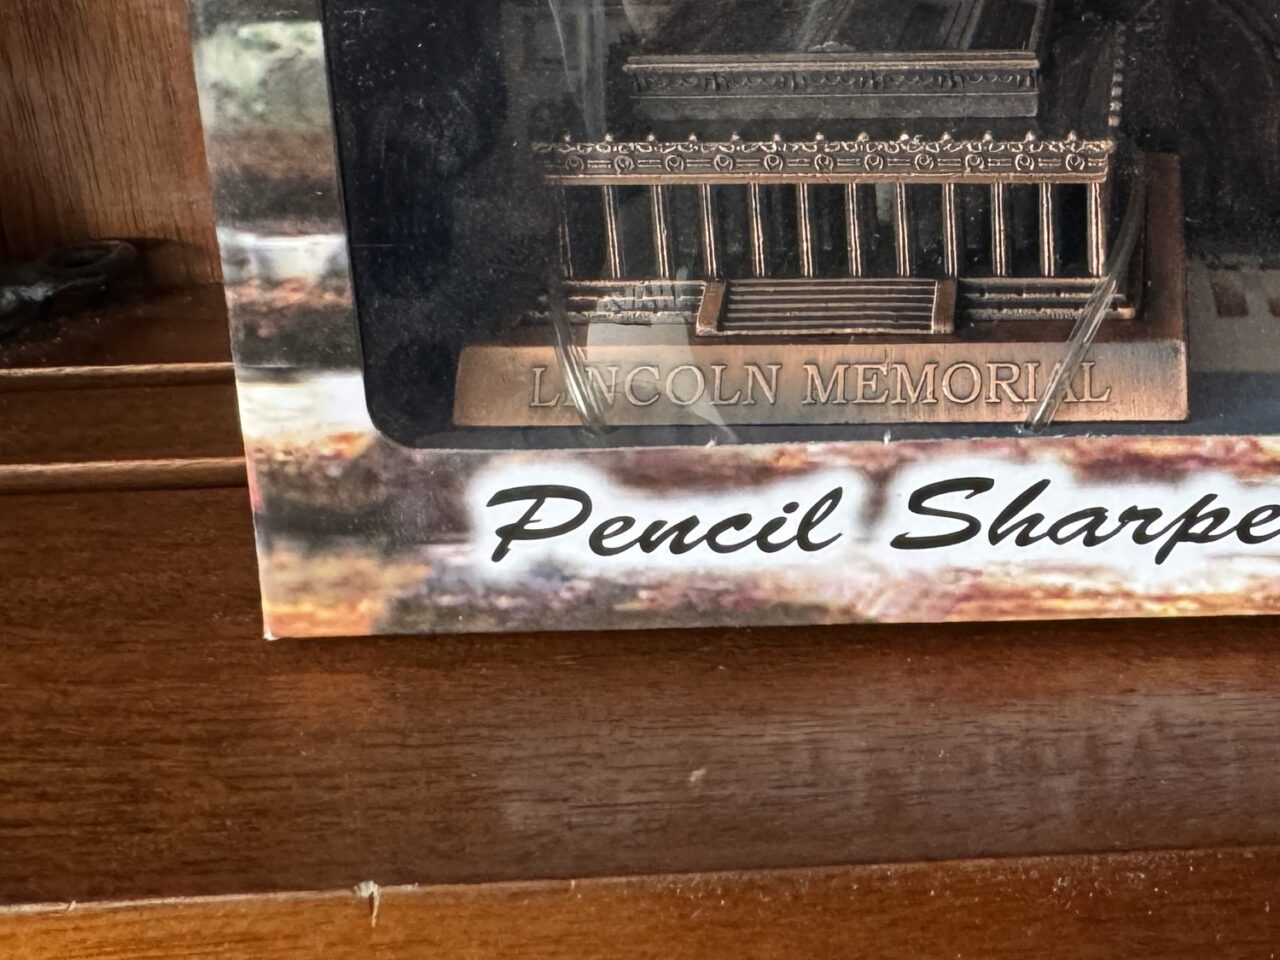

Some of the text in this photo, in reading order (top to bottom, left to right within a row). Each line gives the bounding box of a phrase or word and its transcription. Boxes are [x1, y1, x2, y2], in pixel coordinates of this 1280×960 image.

[529, 360, 1112, 408] LNCOLN MEMORIAL
[486, 484, 844, 563] Pencil
